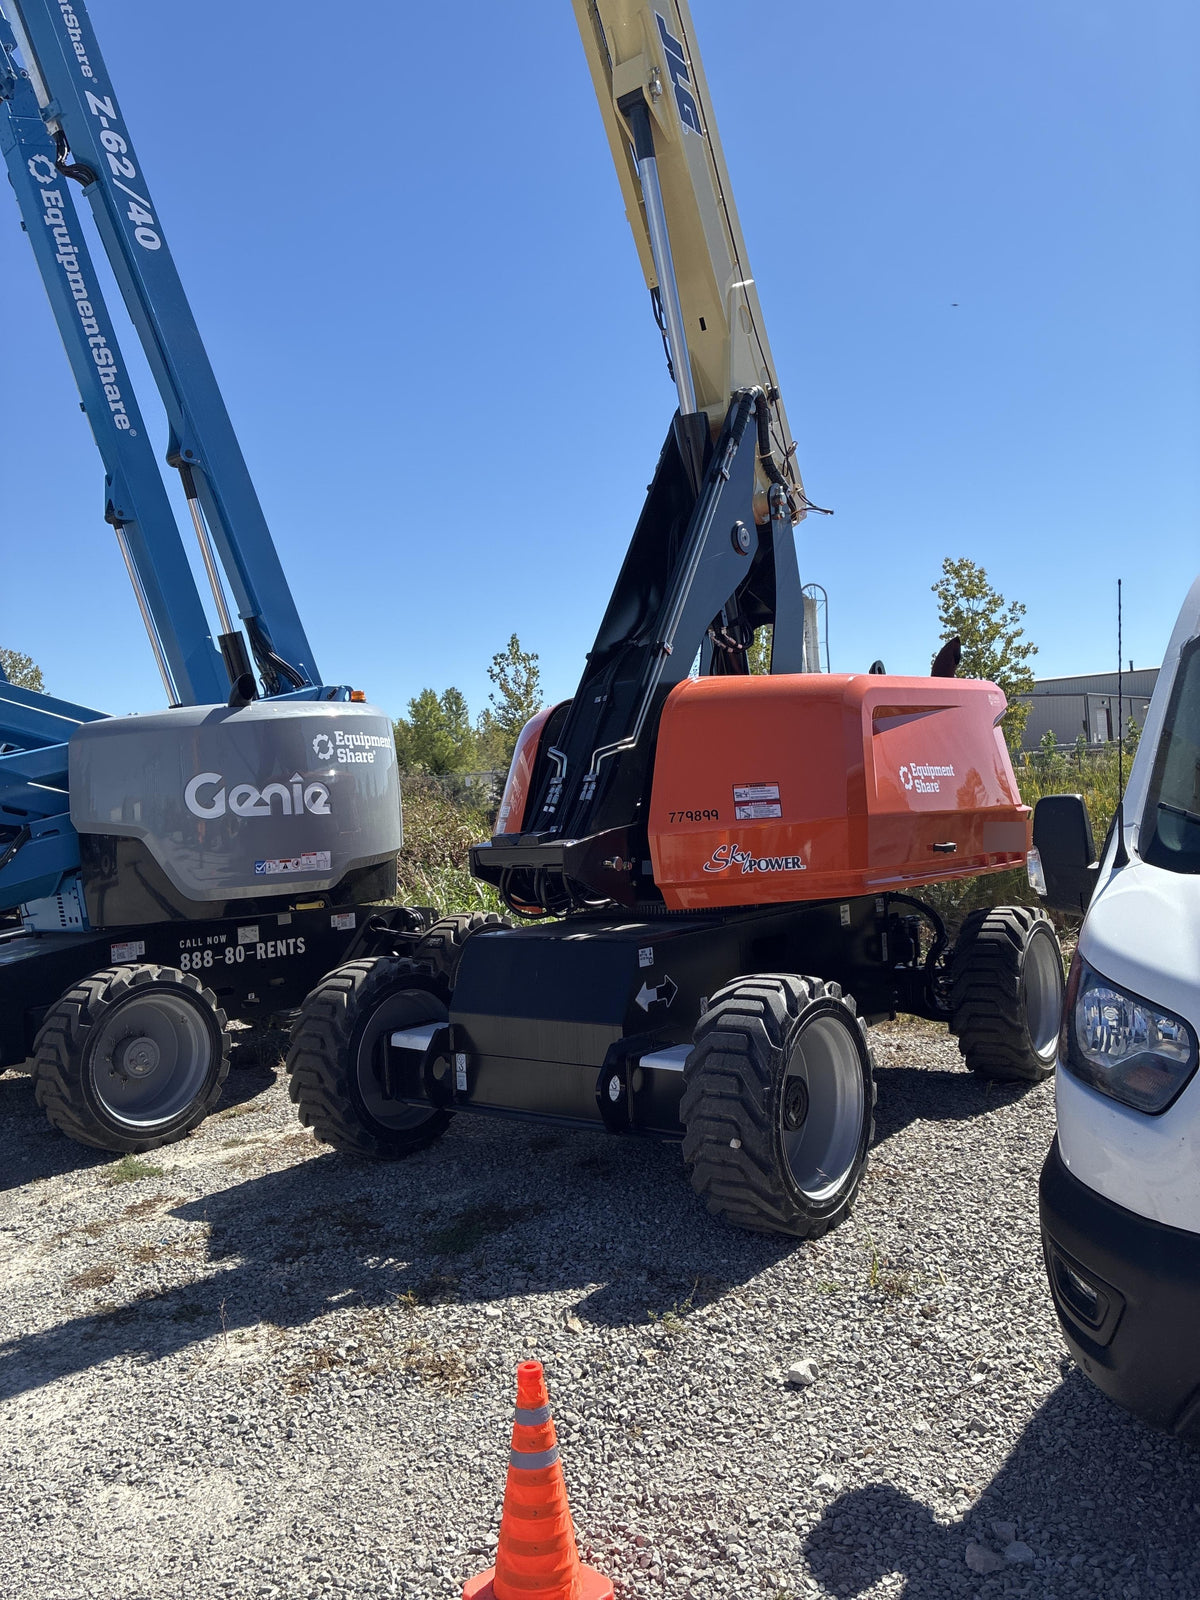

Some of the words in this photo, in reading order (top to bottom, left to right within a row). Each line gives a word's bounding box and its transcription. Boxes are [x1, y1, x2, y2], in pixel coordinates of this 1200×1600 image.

[654, 10, 704, 137] JLG
[84, 90, 162, 251] Z-62/40
[40, 188, 131, 431] EquipmentShare
[334, 730, 392, 750] Equipment
[337, 748, 375, 763] Share
[909, 762, 956, 780] Equipment
[184, 771, 332, 820] Genie
[914, 779, 940, 793] Share
[668, 809, 719, 823] 779899
[179, 937, 203, 949] CALL
[206, 934, 227, 946] NOW
[180, 936, 306, 971] 888-80-RENTS
